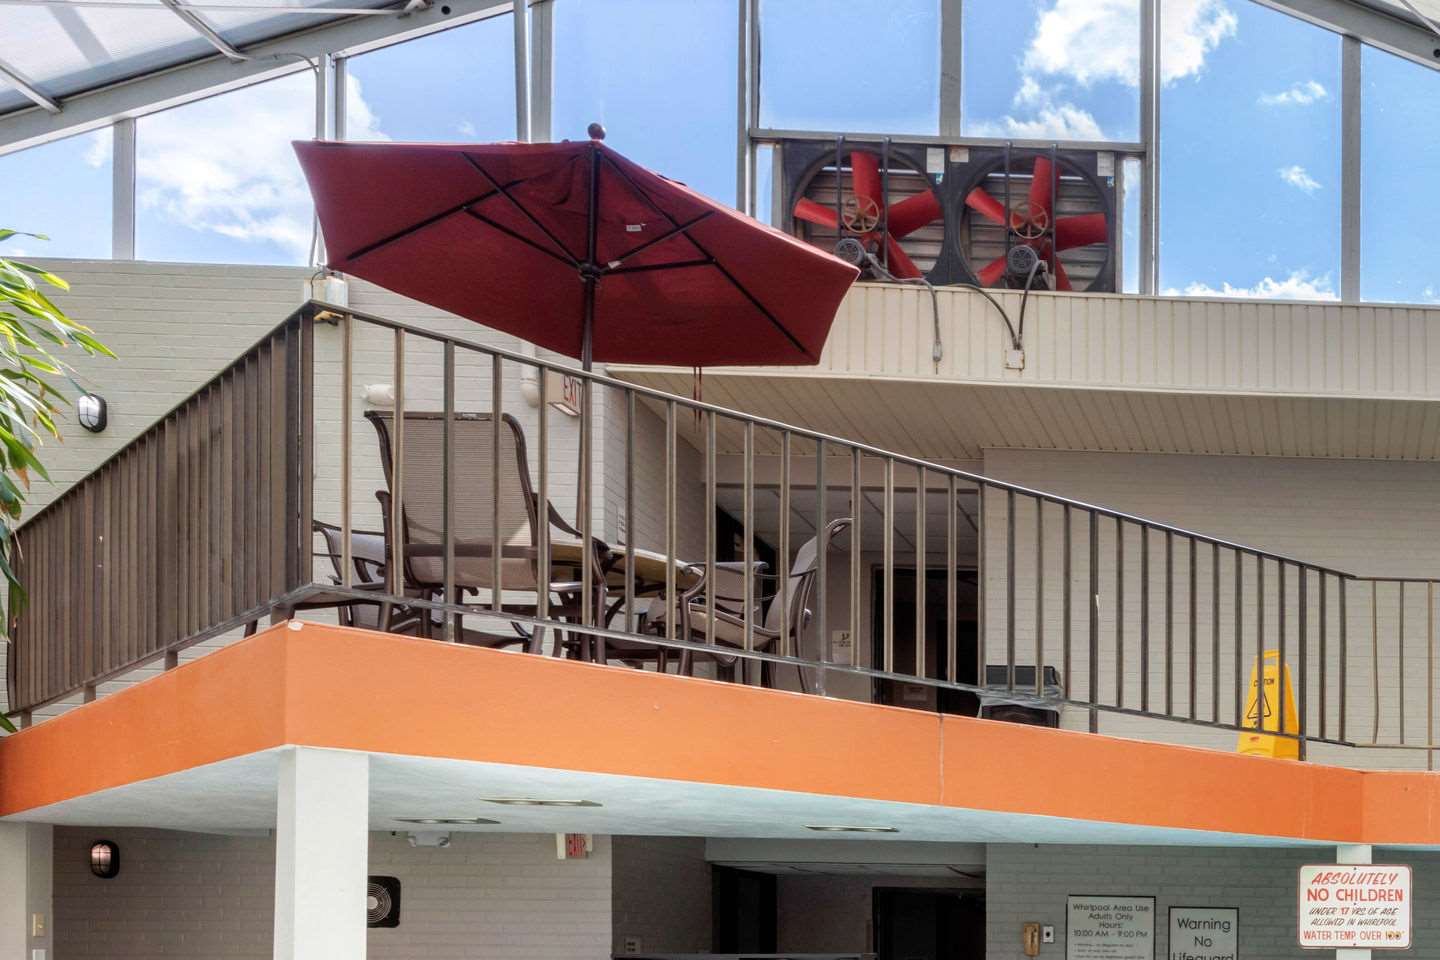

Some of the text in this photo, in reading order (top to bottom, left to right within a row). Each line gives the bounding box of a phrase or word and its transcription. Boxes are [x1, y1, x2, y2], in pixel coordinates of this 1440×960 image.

[1312, 872, 1398, 885] ABSOLUTELY
[1307, 888, 1403, 902] NO CHILDREN
[1072, 904, 1150, 912] Whirlpool Area Use
[1309, 907, 1399, 916] UNDER 17 OF AGE
[1088, 912, 1134, 920] Adults Only
[1176, 917, 1231, 933] Warning
[1310, 918, 1398, 926] ALLOWED IN WHIRLPOOL
[1304, 930, 1332, 940] WATER
[1334, 930, 1356, 940] TEMP
[1360, 930, 1382, 940] OVER
[1194, 936, 1213, 948] No
